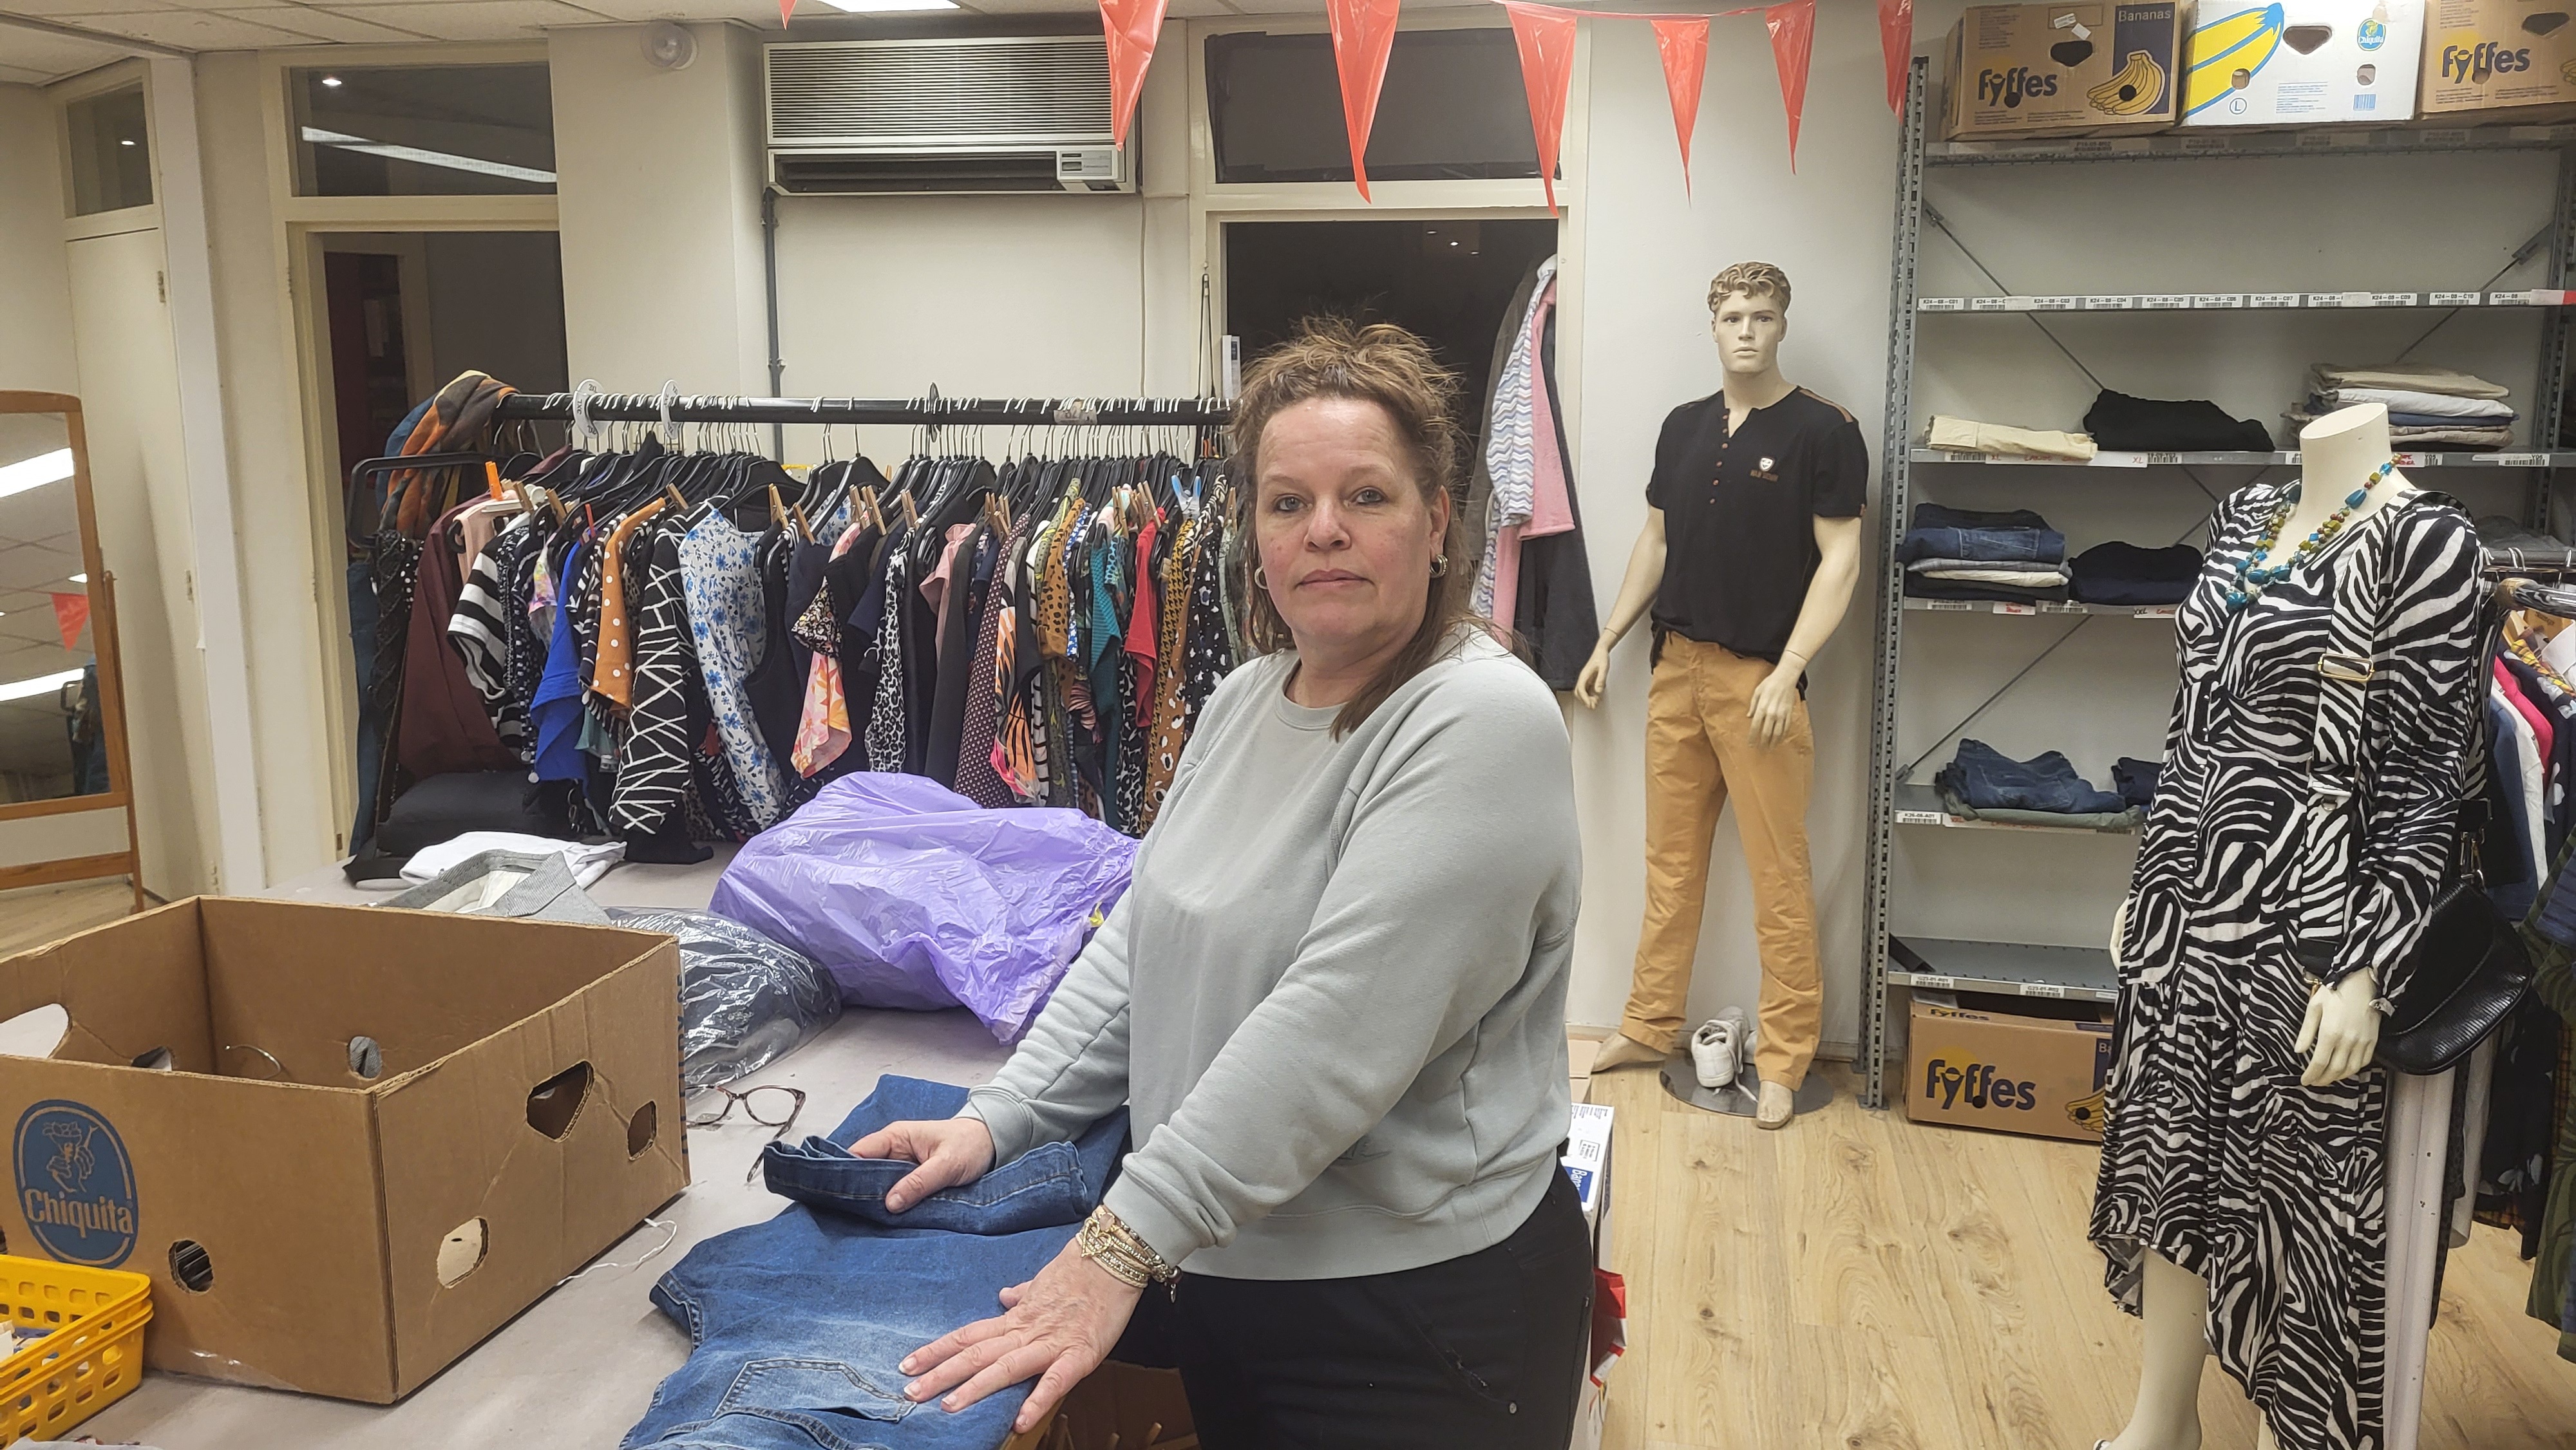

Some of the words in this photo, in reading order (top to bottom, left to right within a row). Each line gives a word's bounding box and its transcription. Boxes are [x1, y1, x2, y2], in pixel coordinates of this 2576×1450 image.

[2118, 10, 2171, 23] Bananas
[2358, 35, 2384, 46] Chiquita
[2132, 456, 2144, 464] XL
[2133, 607, 2148, 616] XXL
[24, 1188, 134, 1239] Chiquita
